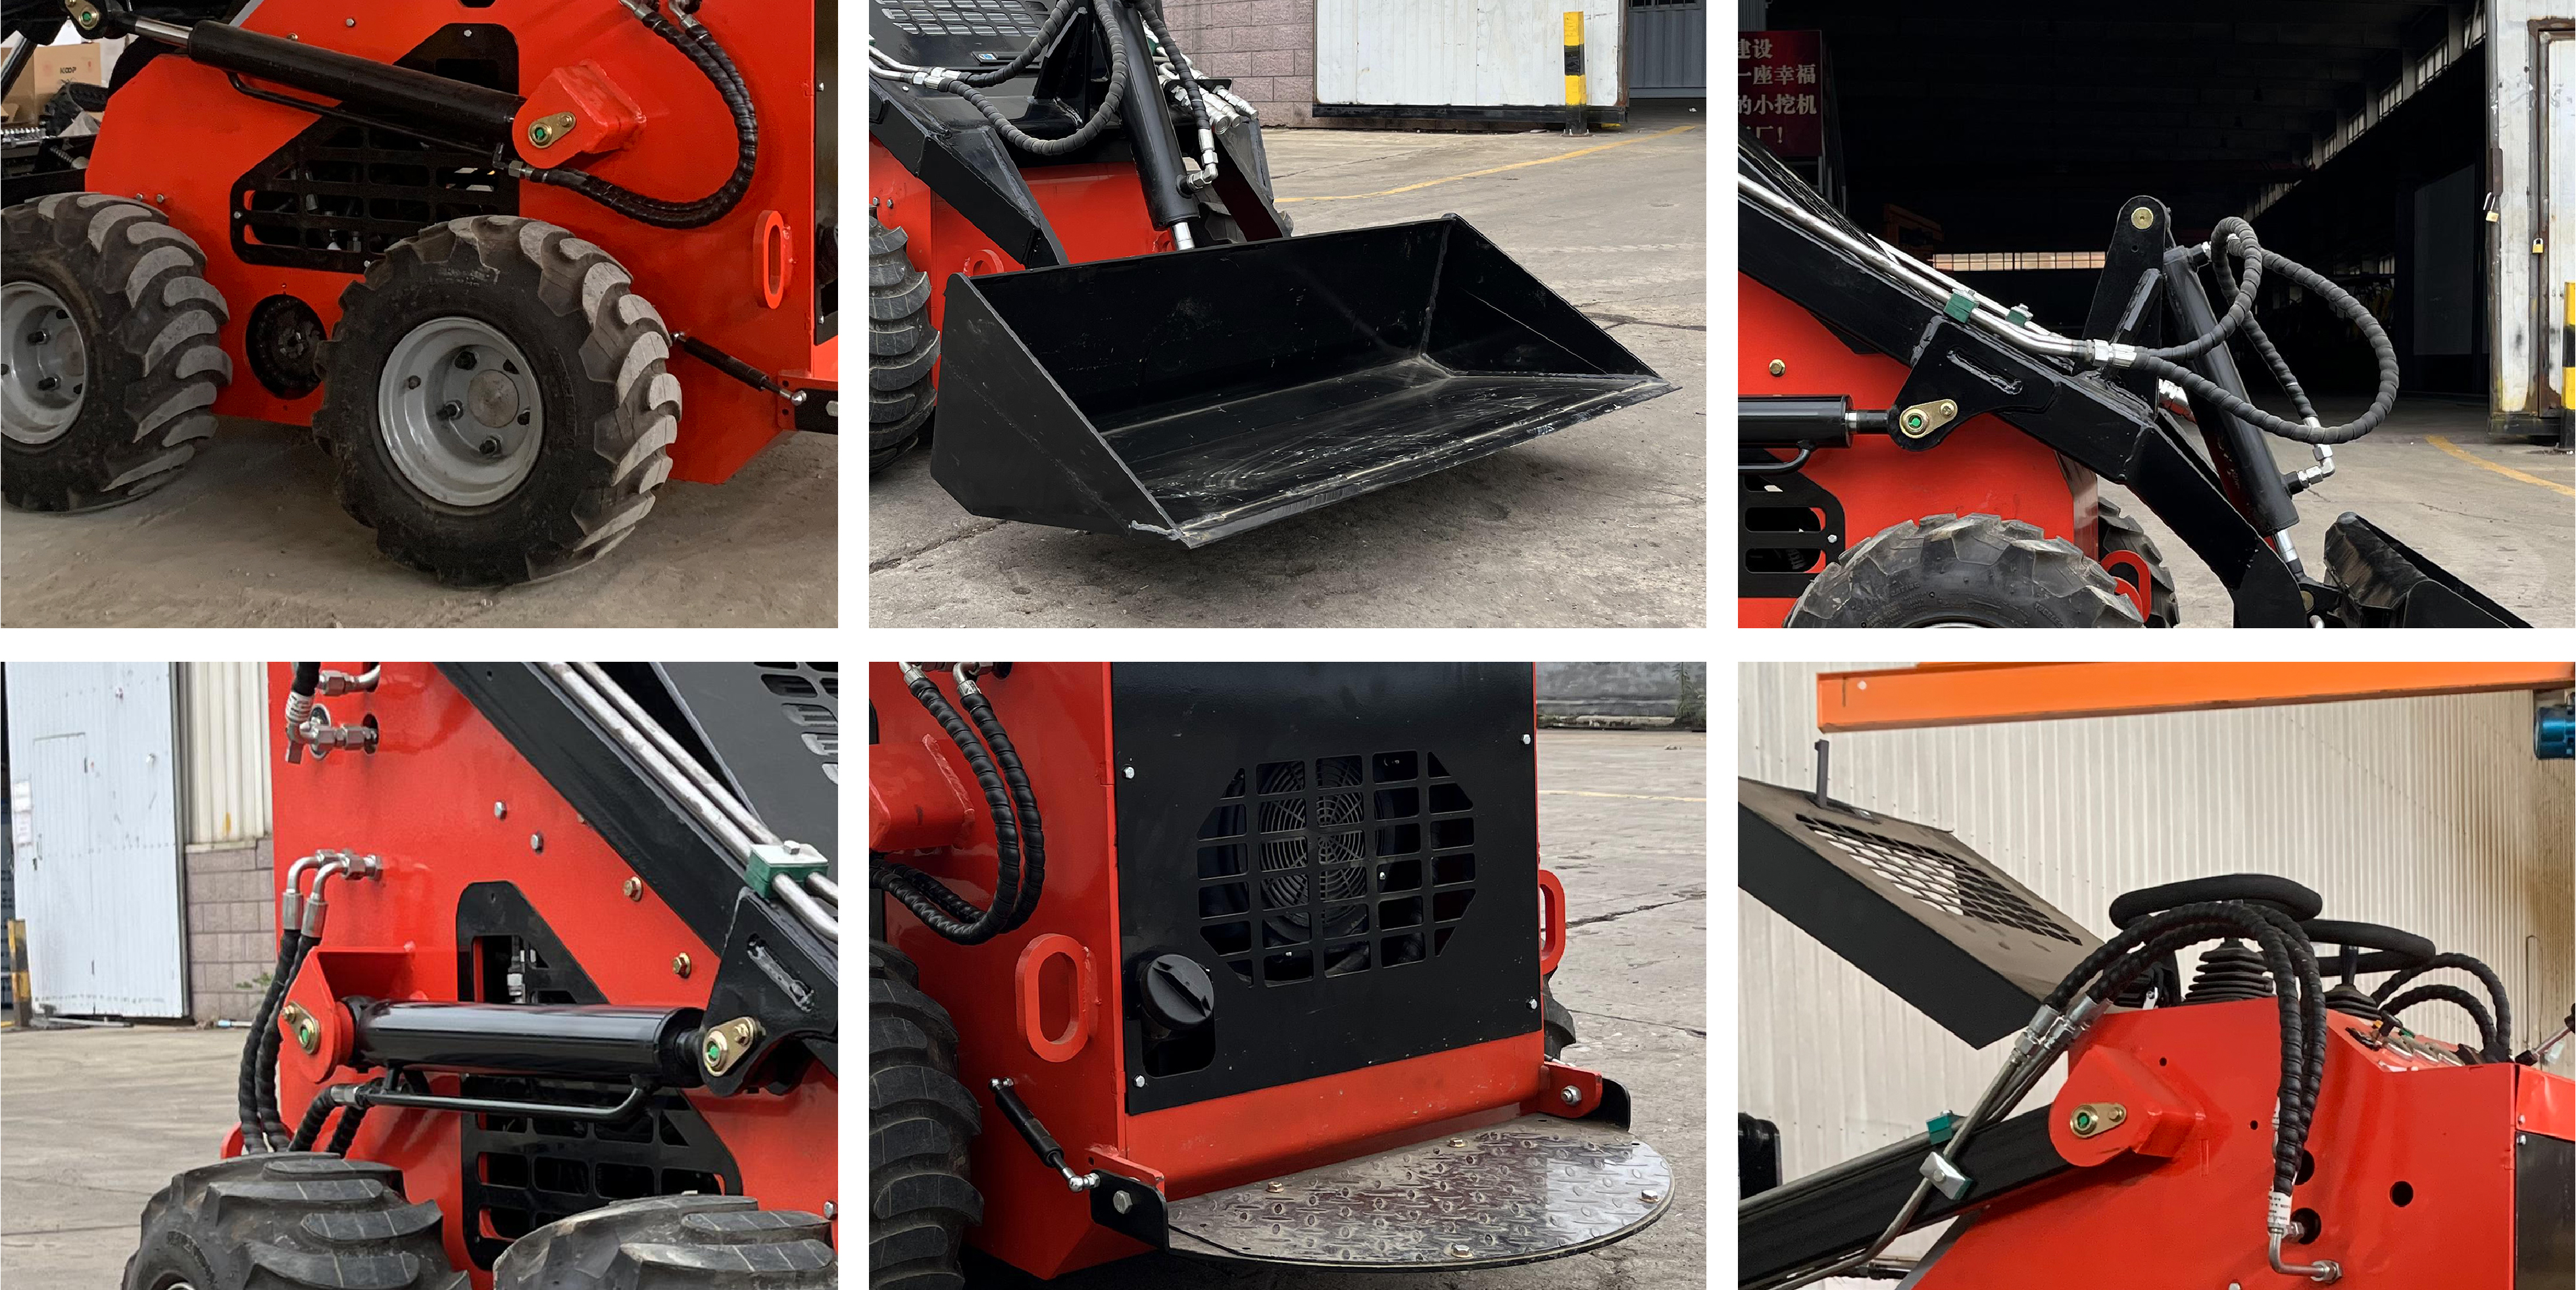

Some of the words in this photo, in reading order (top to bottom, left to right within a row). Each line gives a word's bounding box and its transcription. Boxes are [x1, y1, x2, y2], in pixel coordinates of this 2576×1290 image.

[1738, 38, 1773, 59] 建设
[1738, 64, 1816, 86] 一座幸福
[1738, 93, 1818, 115] 的小挖机
